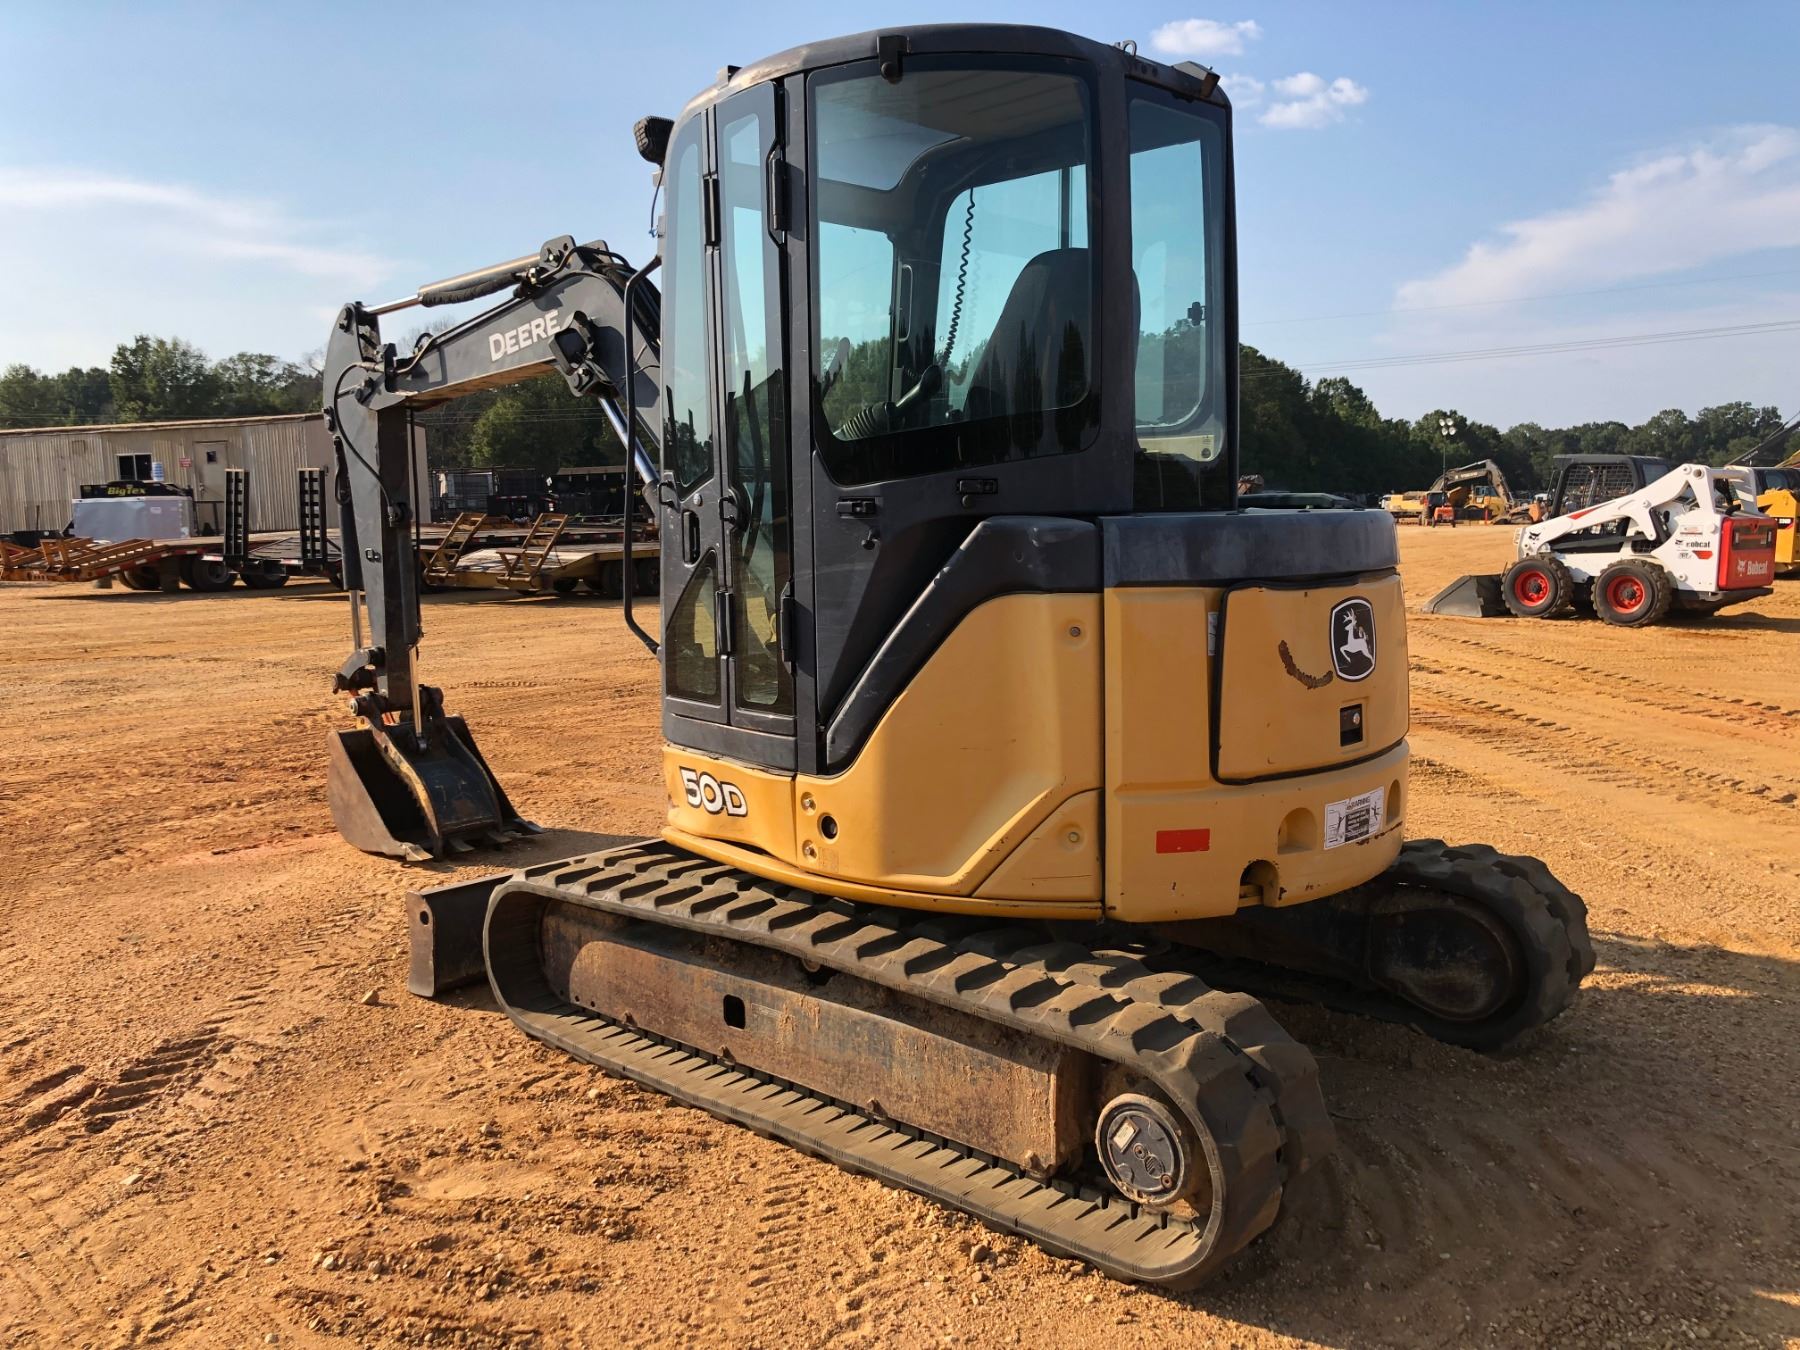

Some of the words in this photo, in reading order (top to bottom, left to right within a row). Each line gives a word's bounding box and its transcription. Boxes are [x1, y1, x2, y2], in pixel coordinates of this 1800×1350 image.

[488, 309, 561, 362] DEERE
[1747, 560, 1768, 576] Bobcat
[679, 765, 748, 818] 50D
